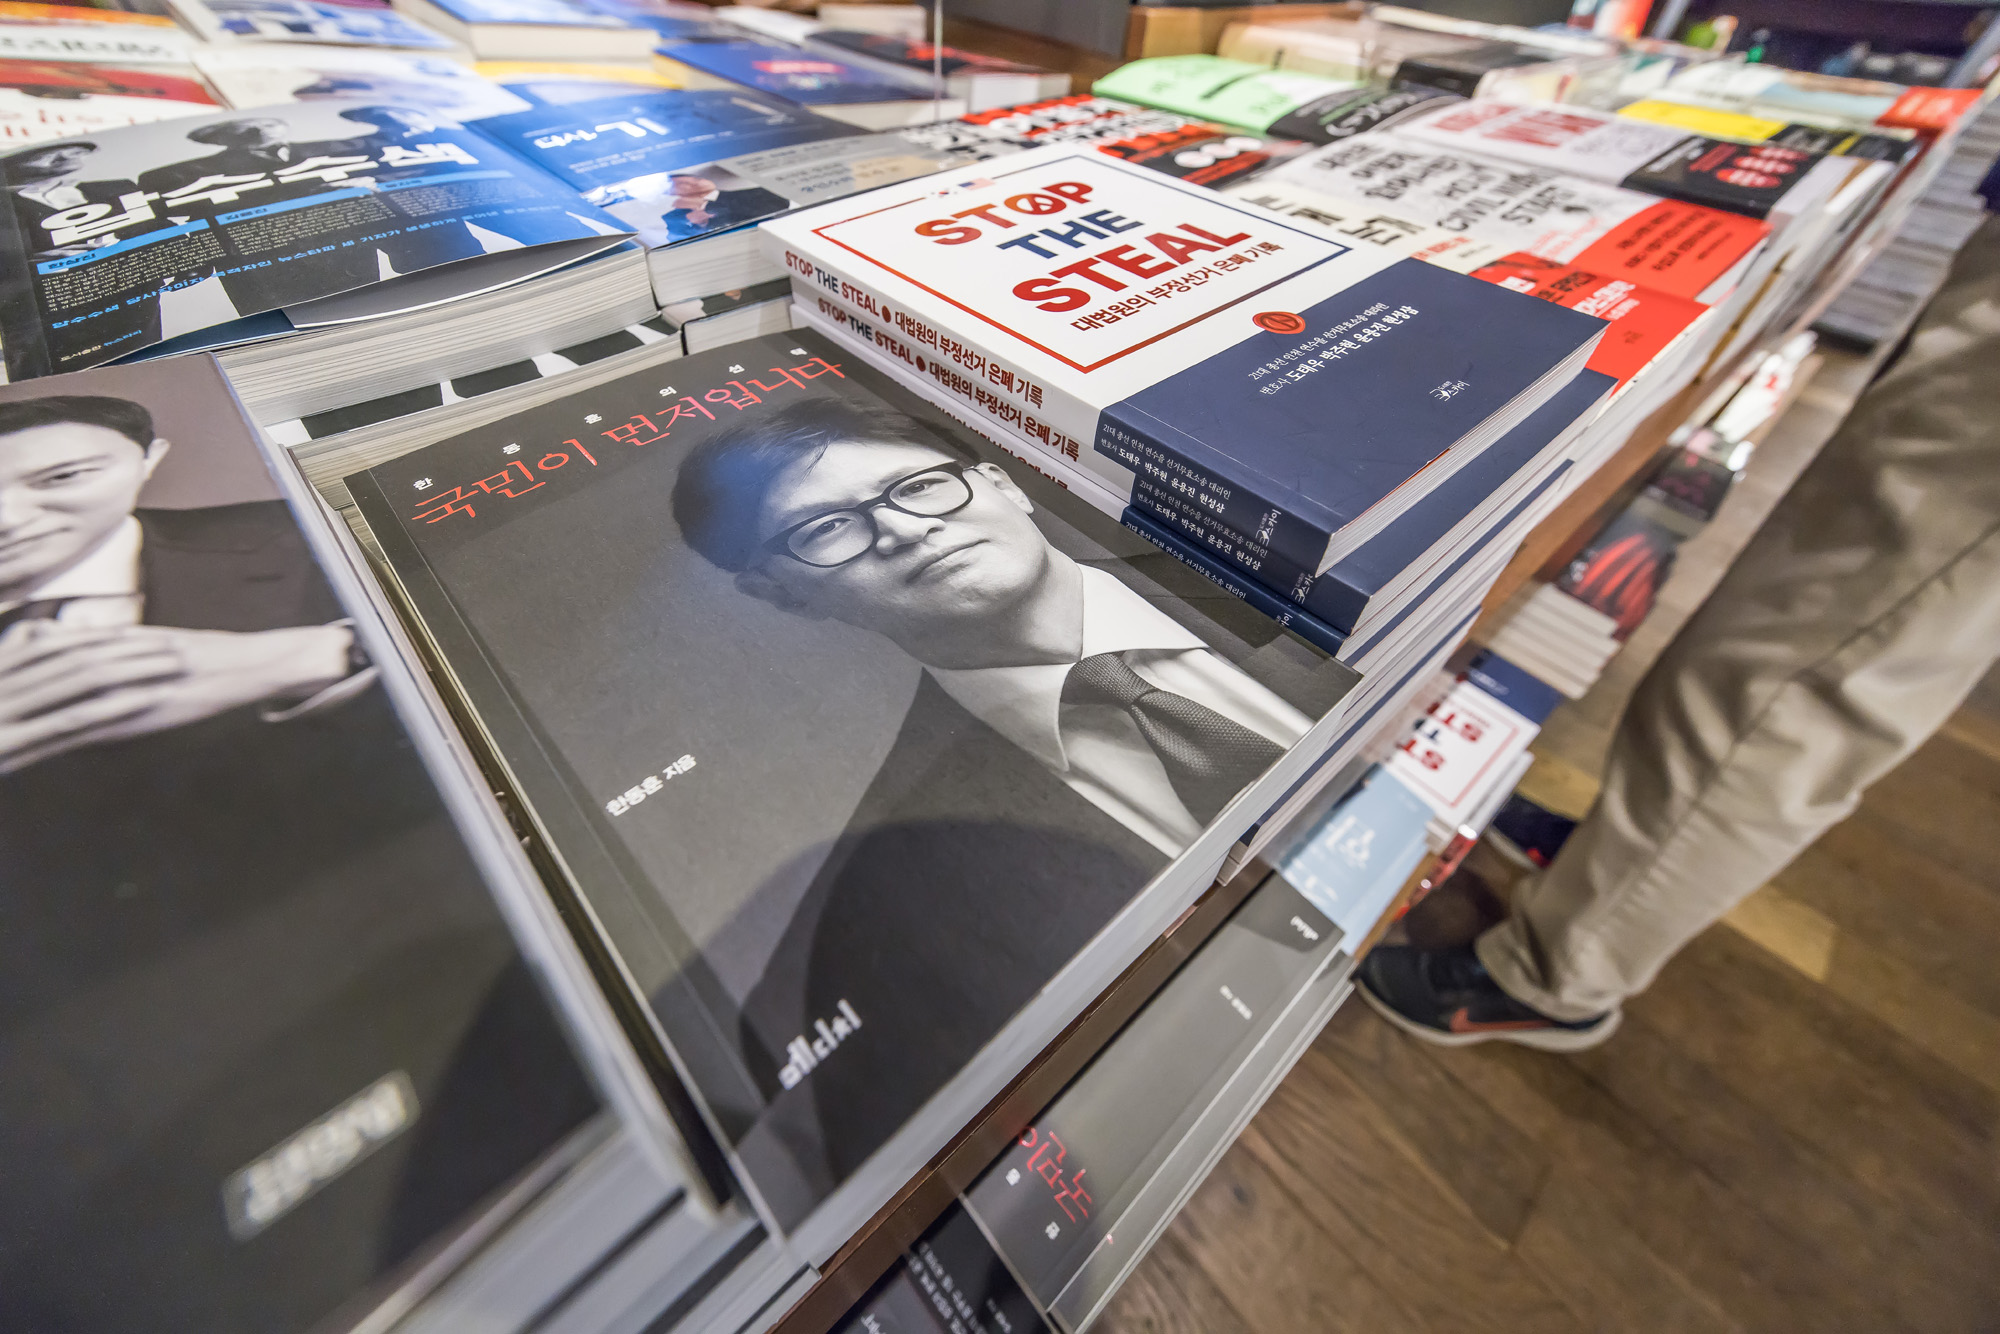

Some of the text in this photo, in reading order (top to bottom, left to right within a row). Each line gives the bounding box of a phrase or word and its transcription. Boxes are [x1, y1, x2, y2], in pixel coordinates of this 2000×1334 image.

[40, 142, 480, 246] 압수수색
[914, 181, 1094, 245] STOP
[996, 209, 1144, 259] THE
[52, 304, 120, 329] 압수수색
[126, 276, 205, 305] 당사자이자
[360, 229, 401, 244] 기자가
[1012, 223, 1253, 313] STEAL
[1070, 241, 1284, 331] 대법원의 부정선거 은폐 기록
[785, 251, 1043, 409] STOP THE STEAL 대법원의 부정선거 은폐 기록
[1248, 302, 1390, 380] 21대 총선 인천 연수을 선거무효소송 대리인
[1259, 305, 1419, 395] 변호사 도태우 박주현 윤용진 현성삼
[818, 297, 1079, 462] STOP THE STEAL 대법원의 부정선거 은폐 기록
[411, 438, 598, 524] 국민이
[601, 357, 846, 447] 먼저입니다
[413, 477, 434, 491] 한
[659, 386, 677, 397] 의
[1101, 438, 1226, 514] 변호사 도태우 박주현 윤용진 현성삼
[1103, 423, 1232, 501] 21대 총선 인천 연수을 선거무효소송 대리인
[1137, 492, 1262, 571] 변호사 도태우 박주현 윤용진 현성삼
[1139, 479, 1268, 559] 21대 총선 인천 연수을 선거무효소송 대리인
[605, 754, 697, 817] 한동훈 지음
